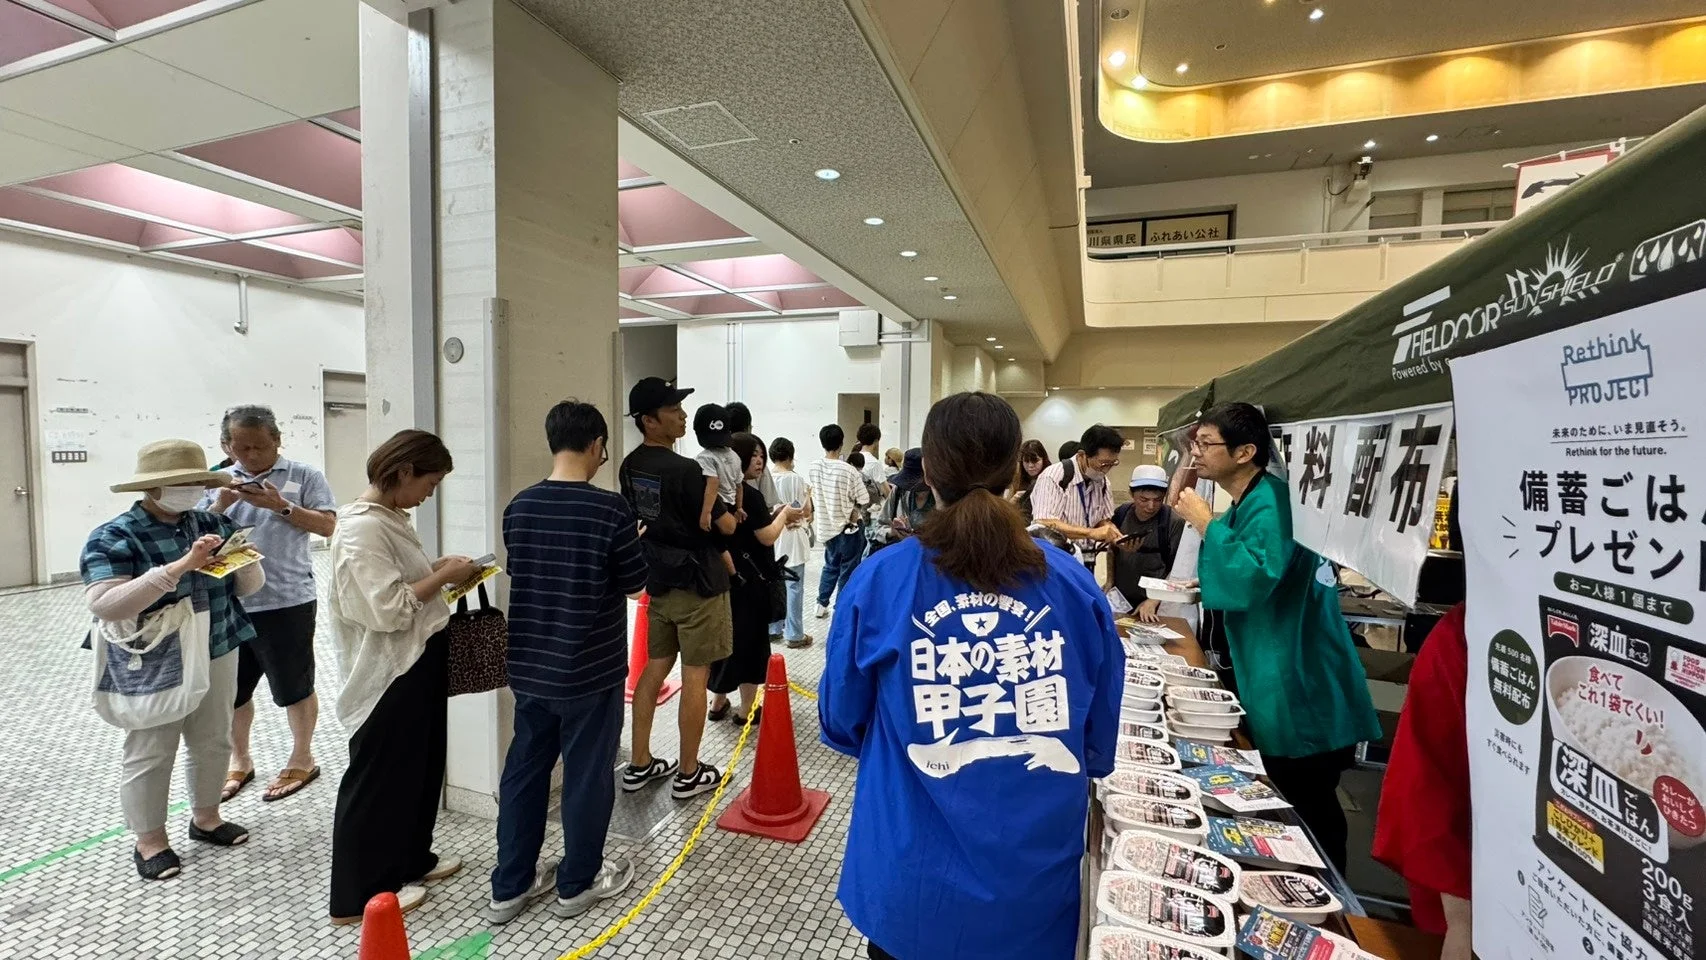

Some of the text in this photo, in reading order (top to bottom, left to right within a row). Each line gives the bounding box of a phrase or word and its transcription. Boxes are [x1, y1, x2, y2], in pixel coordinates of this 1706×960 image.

[1150, 227, 1220, 243] ふれあい公社
[1411, 303, 1499, 359] FIELDOOR
[1562, 328, 1646, 365] Rethink
[1392, 360, 1427, 381] Powered
[1430, 358, 1442, 374] by
[1566, 374, 1652, 406] PROJECT
[1552, 419, 1686, 438] 未来のために、いま見直そう。
[1566, 445, 1667, 457] Rethink for the future.
[1519, 470, 1706, 526] 備蓄ごは
[1535, 520, 1706, 592] プレゼン
[911, 630, 1065, 685] 日本の素材
[1490, 656, 1536, 691] 備蓄ごはん
[912, 674, 1070, 739] 甲子園
[1493, 677, 1531, 709] 無料配布
[926, 759, 950, 771] ichi
